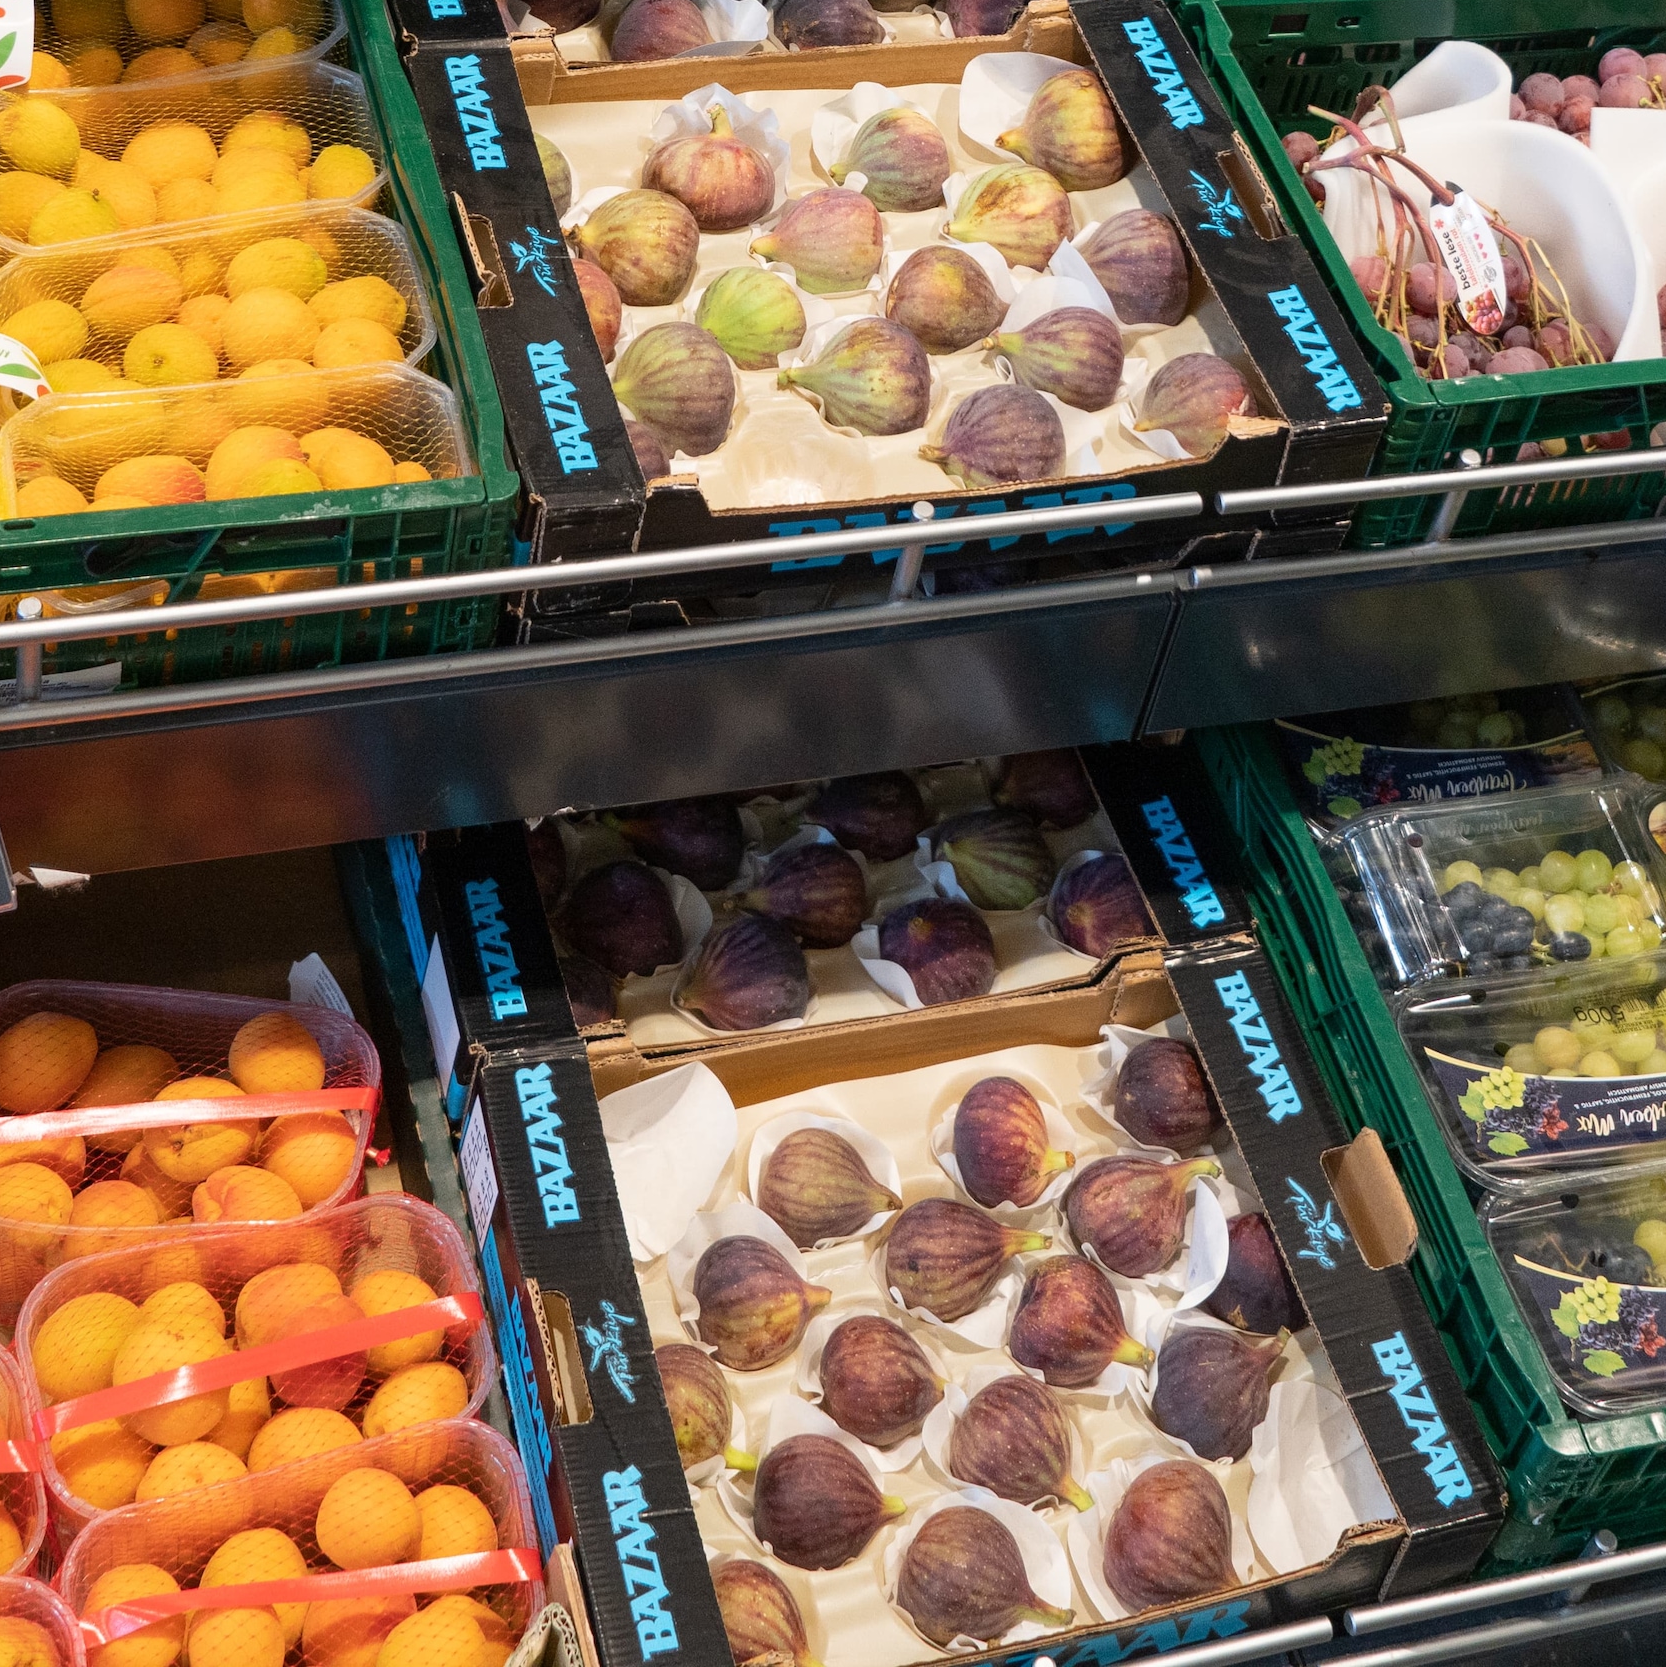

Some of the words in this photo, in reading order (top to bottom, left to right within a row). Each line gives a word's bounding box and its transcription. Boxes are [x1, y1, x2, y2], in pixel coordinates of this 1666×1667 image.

[444, 53, 508, 171] BAZAAR
[1121, 16, 1206, 131] BAZAAR
[1442, 231, 1460, 260] lese
[1452, 260, 1471, 291] beste
[526, 339, 599, 475] BAZAAR
[1267, 284, 1364, 413] BAZAAR
[1141, 795, 1226, 930] BAZAAR
[466, 879, 528, 1022] BAZAAR
[1574, 1004, 1624, 1025] 500g
[1214, 970, 1302, 1123] BAZAAR
[513, 1063, 581, 1229] BAZAAR
[1575, 1114, 1616, 1136] Mix
[1371, 1332, 1474, 1508] BAZAAR
[603, 1465, 679, 1661] BAZAAR
